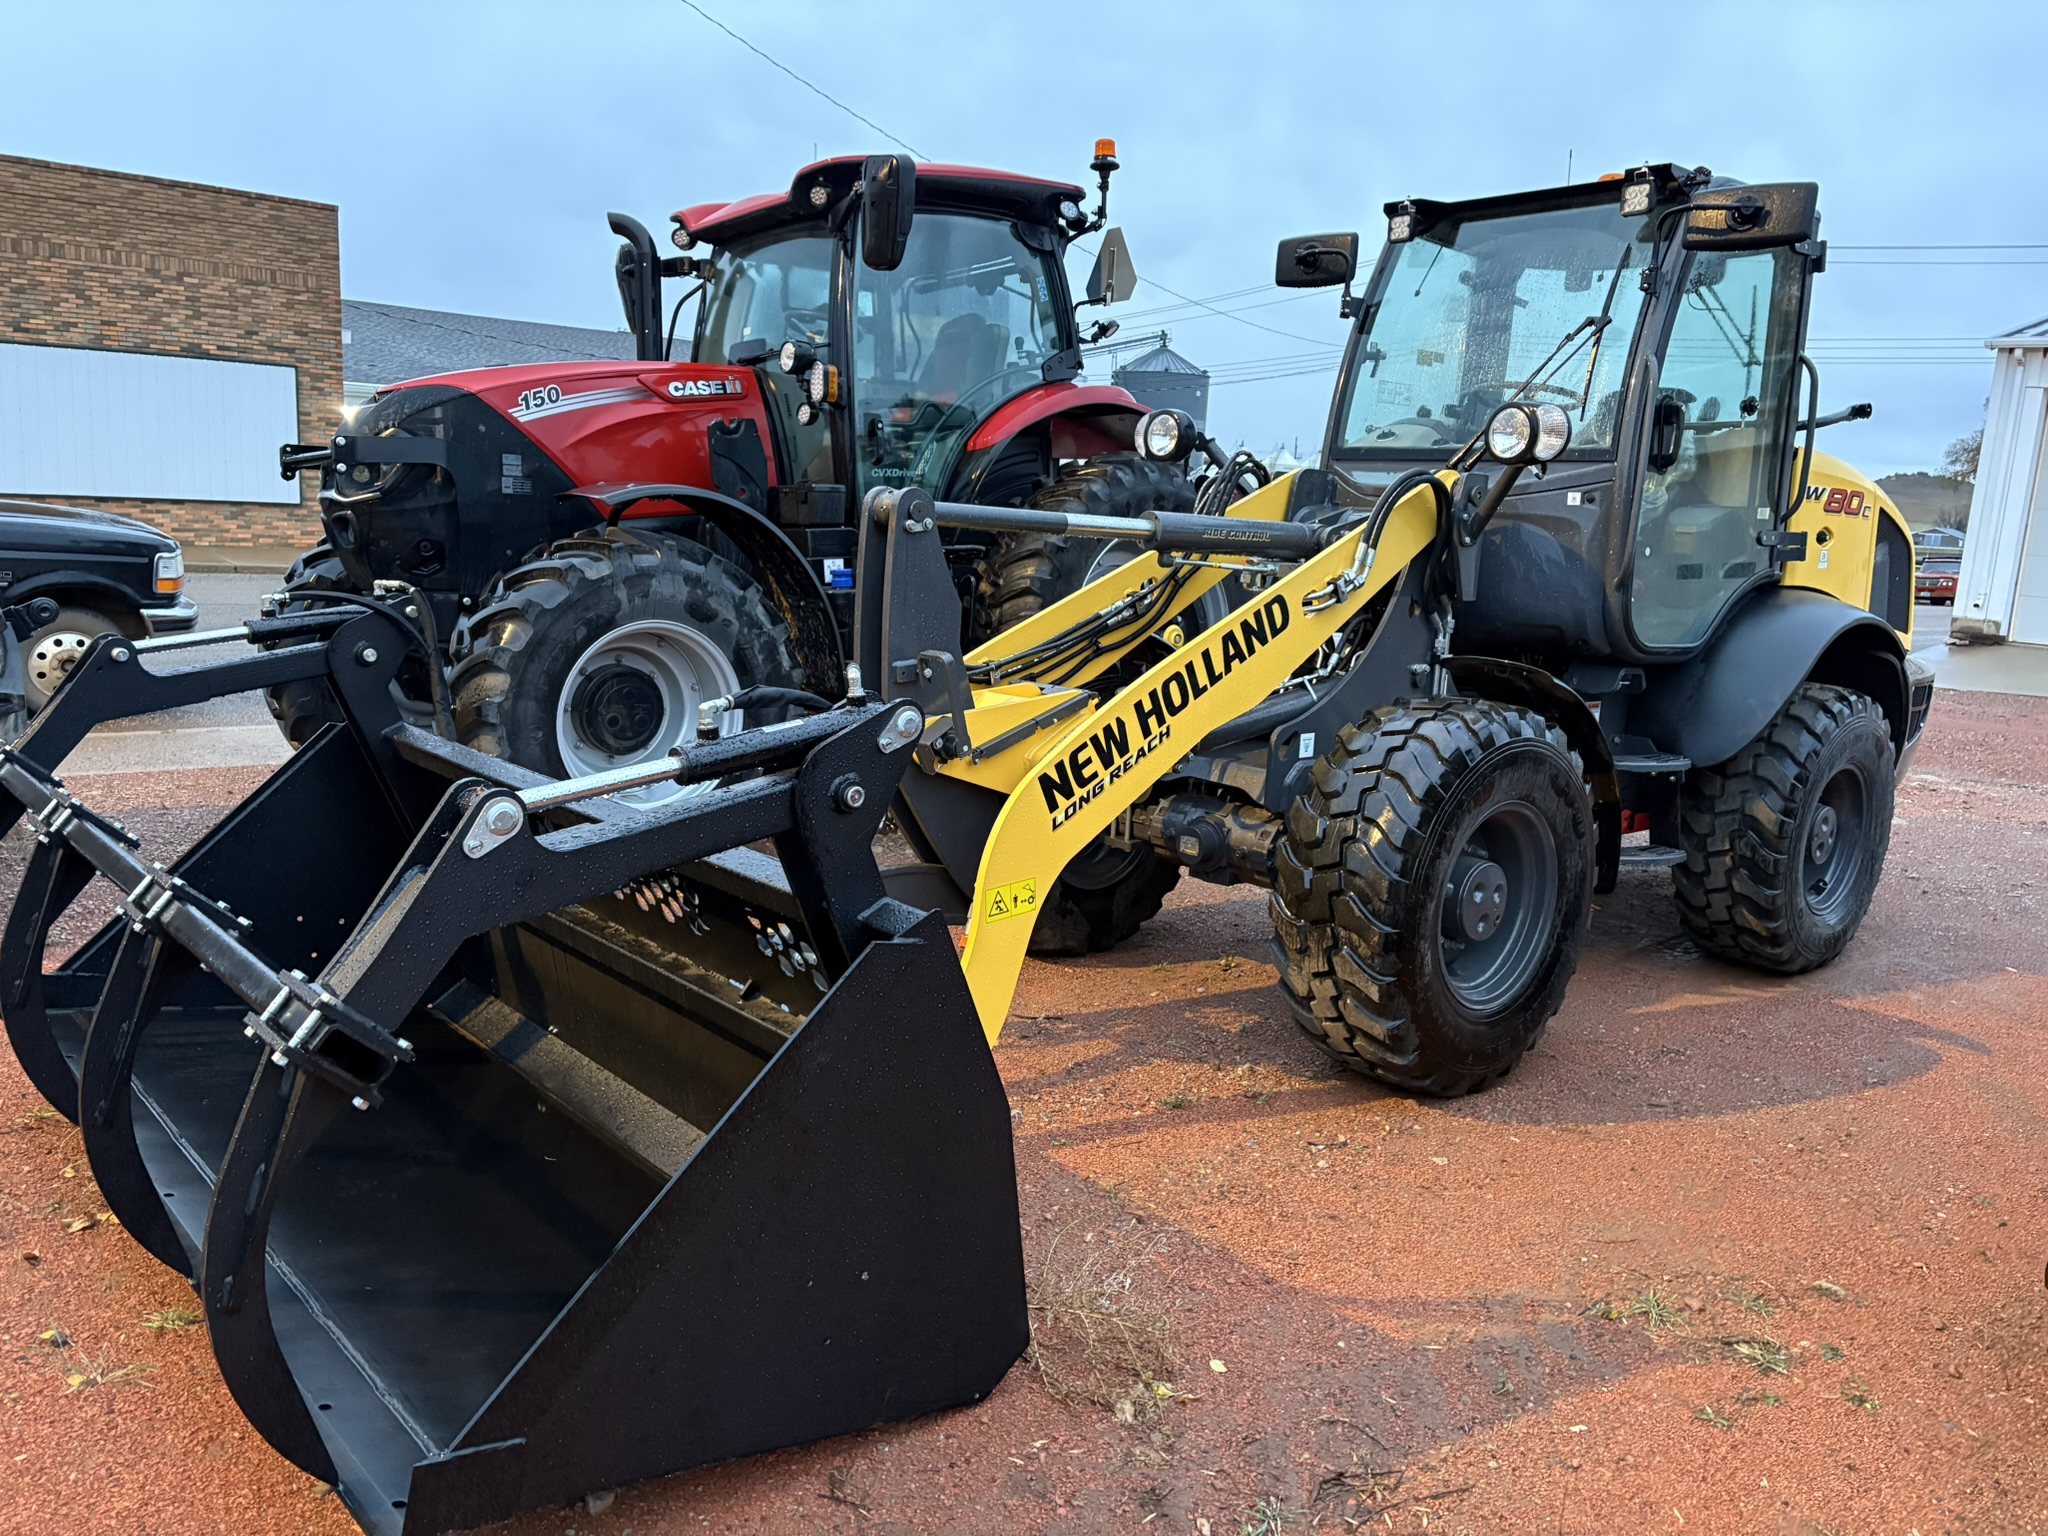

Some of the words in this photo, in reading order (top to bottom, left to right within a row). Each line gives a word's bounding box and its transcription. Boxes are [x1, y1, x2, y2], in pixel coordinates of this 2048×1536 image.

[518, 384, 562, 411] 150
[668, 381, 723, 396] CASE
[1202, 528, 1227, 539] RIDE
[1228, 530, 1271, 541] CONTROL
[1037, 716, 1131, 815] NEW
[1134, 594, 1290, 740] HOLLAND
[1051, 776, 1104, 833] LONG
[1108, 724, 1171, 786] REACH
